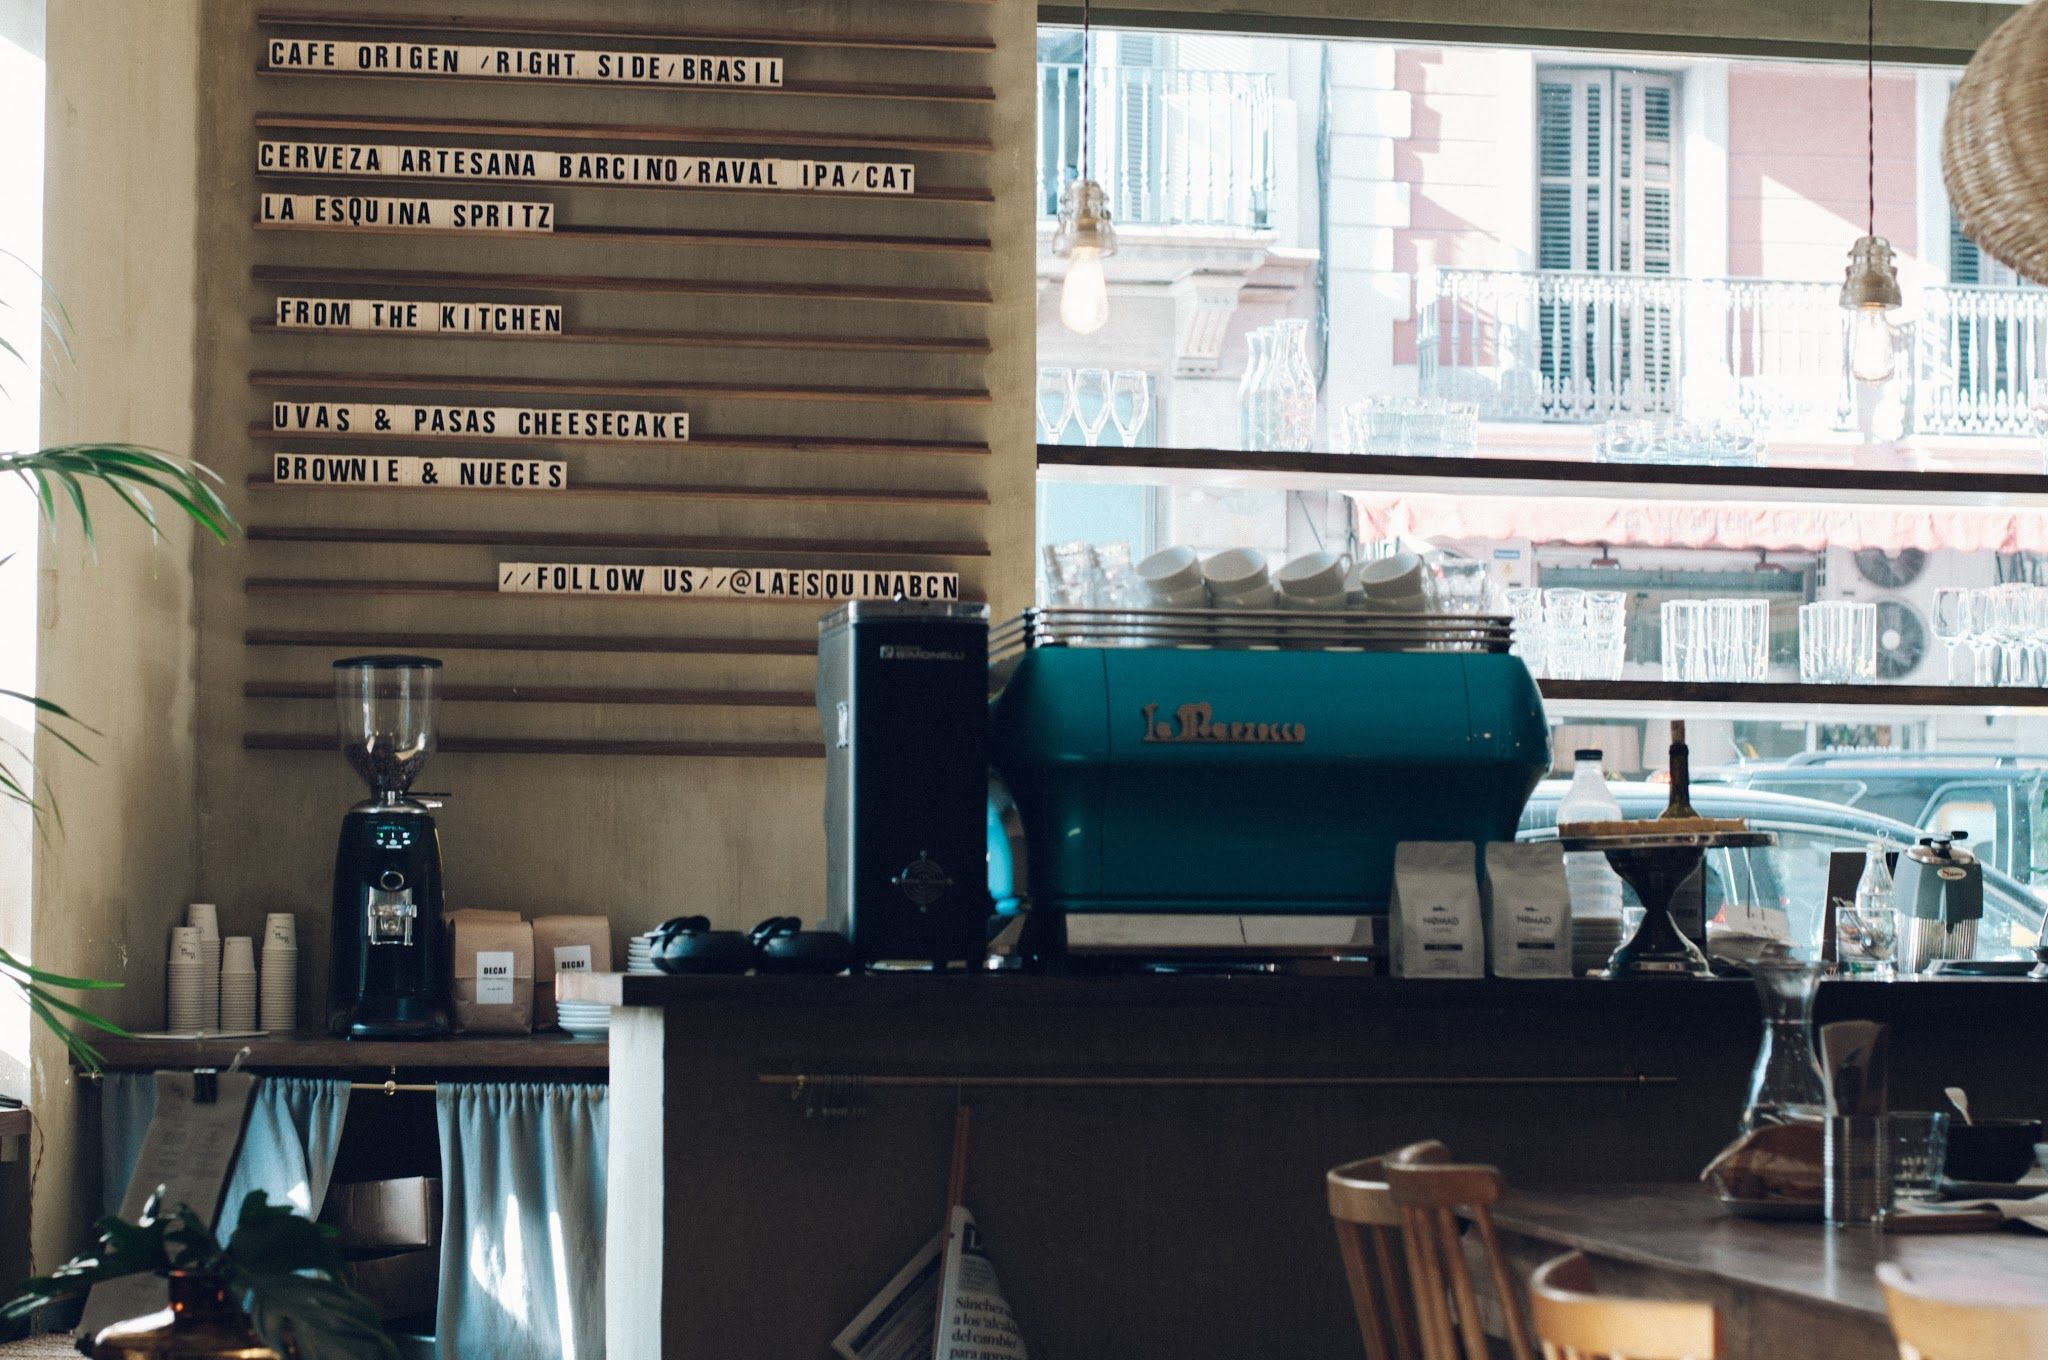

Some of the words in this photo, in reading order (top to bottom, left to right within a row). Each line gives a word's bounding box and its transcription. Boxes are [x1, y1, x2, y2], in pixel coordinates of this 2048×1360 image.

[271, 42, 335, 66] CAFE
[358, 46, 458, 72] ORIGEN
[261, 144, 380, 170] CERVEZA
[401, 150, 536, 176] ARTESANA
[264, 197, 294, 220] LA
[315, 198, 431, 225] ESQUINA
[453, 204, 550, 228] SPRITZ
[280, 300, 350, 325] FROM
[372, 303, 417, 327] THE
[442, 305, 560, 331] KITCHEN
[275, 404, 350, 431] UVAS
[374, 409, 391, 430] &
[414, 408, 496, 433] PASAS
[518, 411, 685, 438] CHEESECAKE
[277, 457, 399, 482] BROWNIE
[421, 462, 438, 484] &
[461, 462, 562, 487] NUECES
[484, 967, 507, 975] DECAF
[562, 960, 585, 969] DECAF
